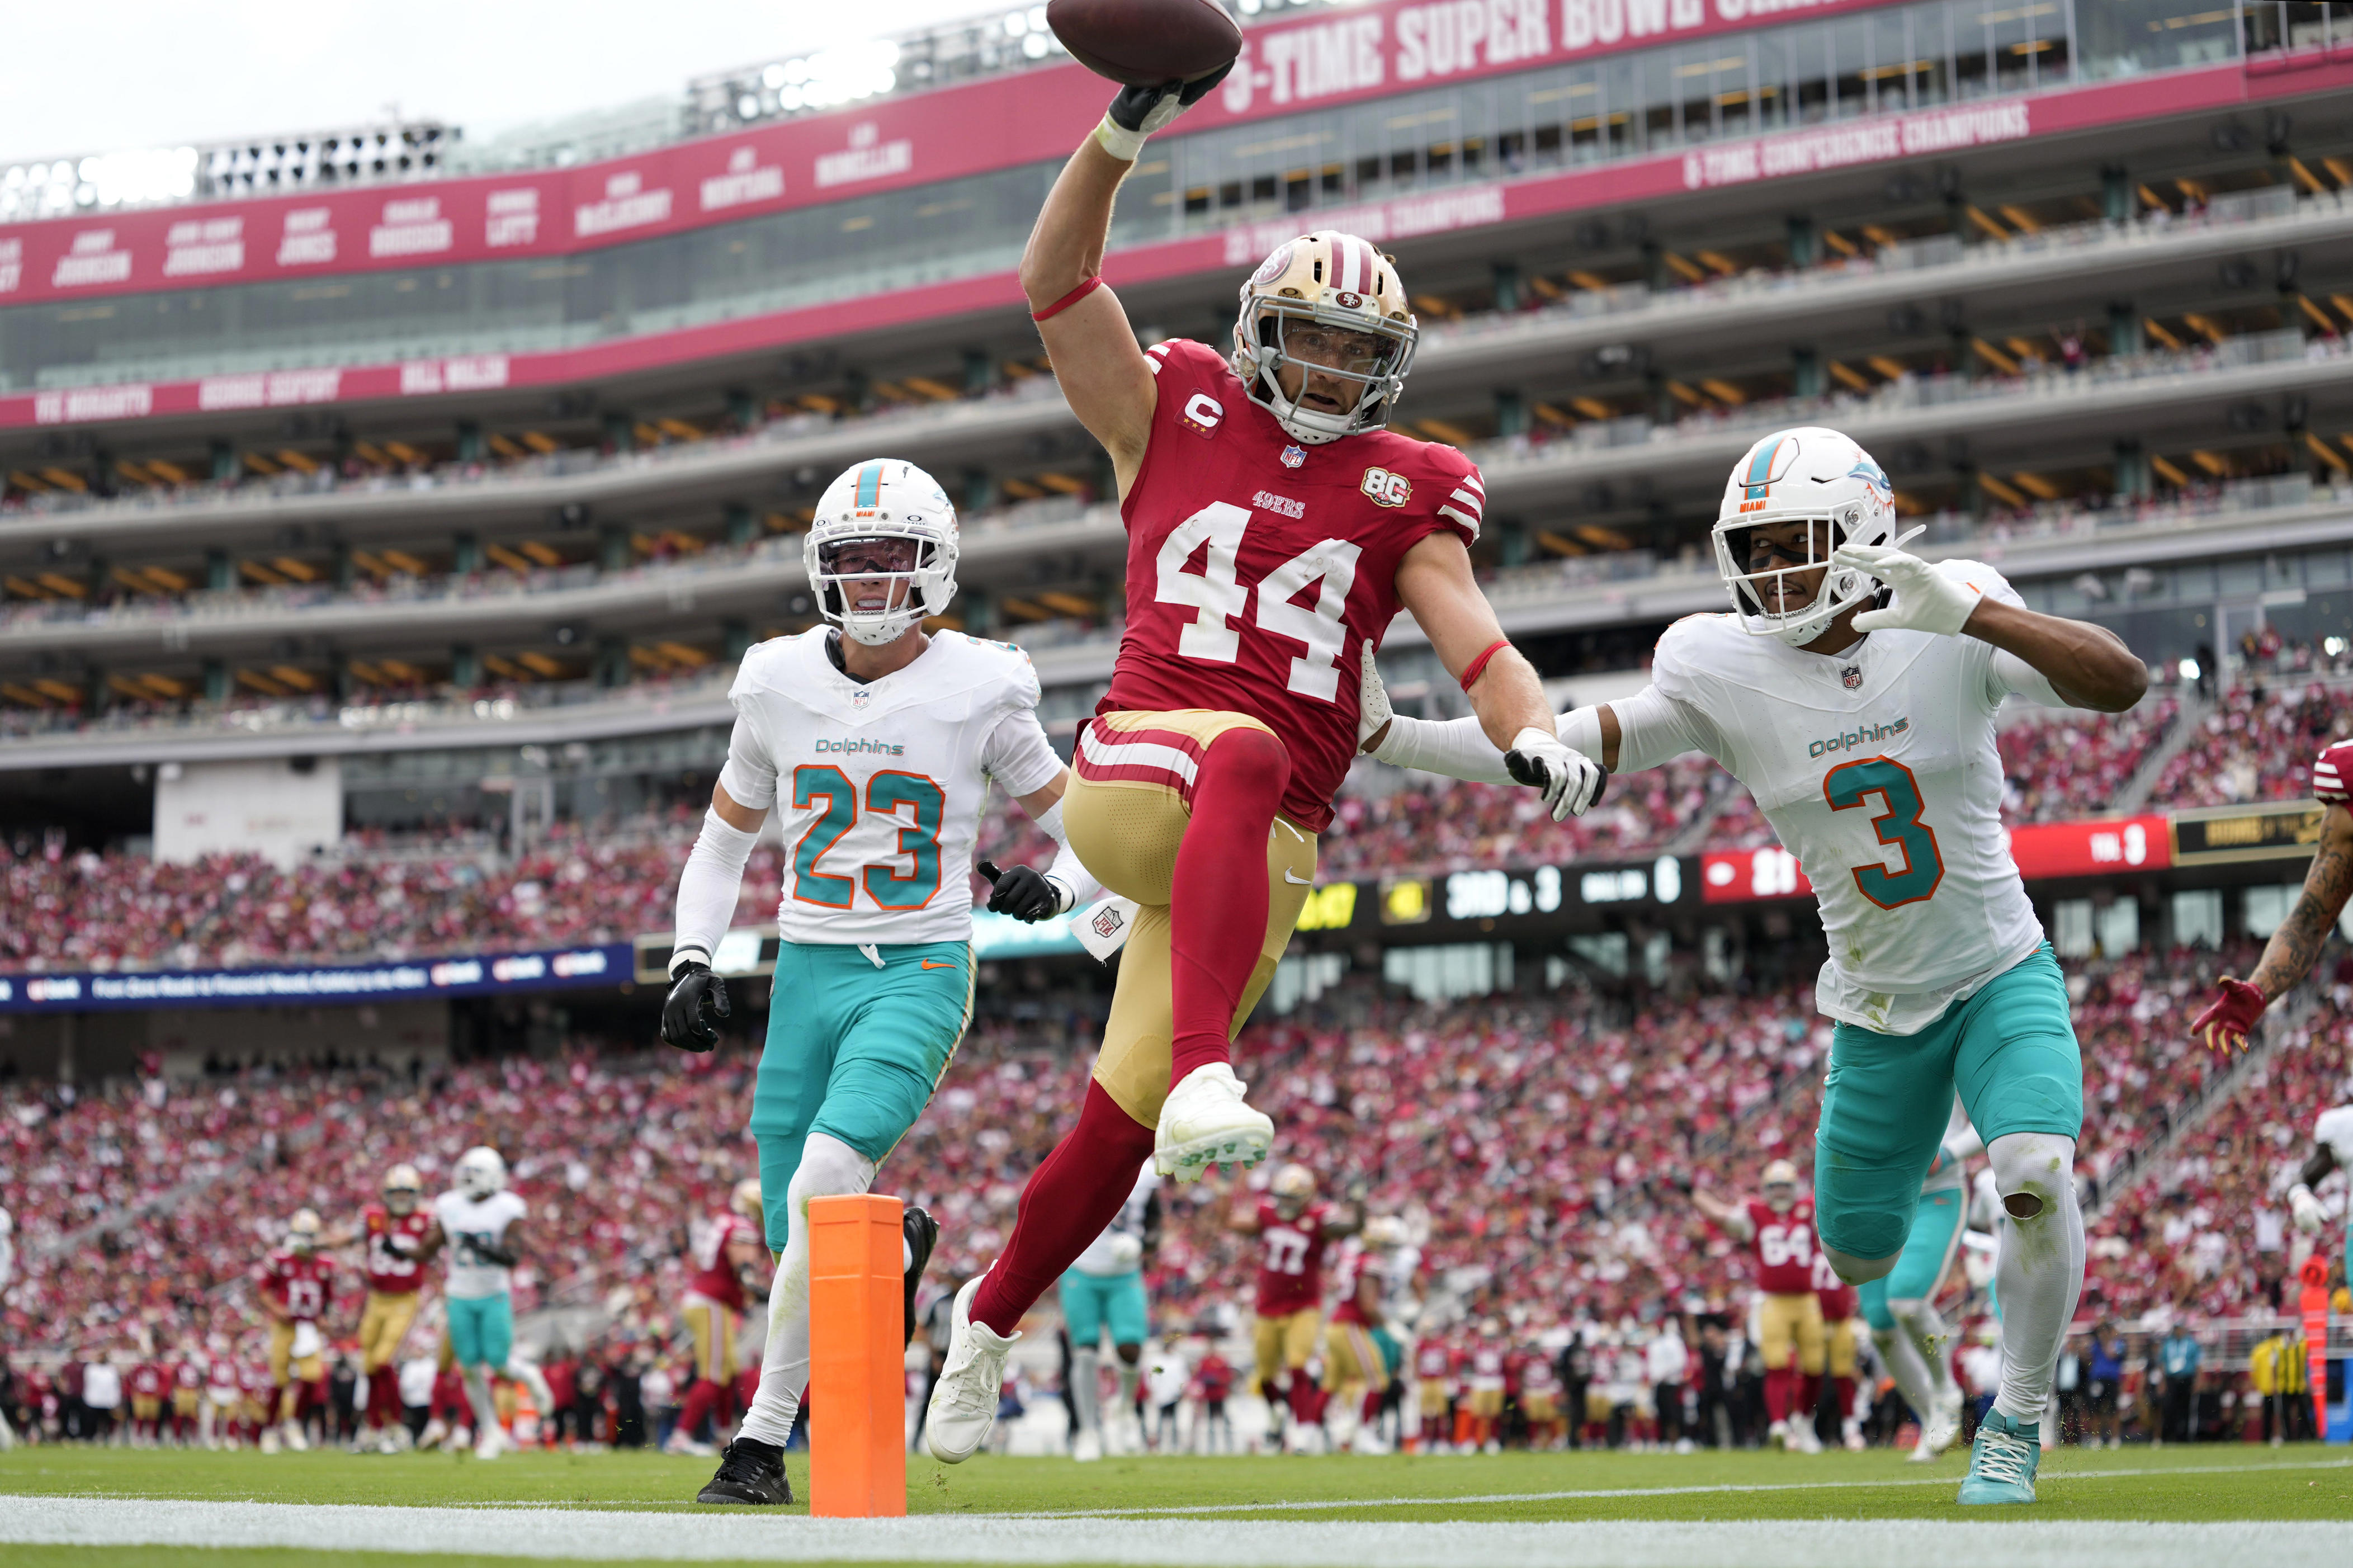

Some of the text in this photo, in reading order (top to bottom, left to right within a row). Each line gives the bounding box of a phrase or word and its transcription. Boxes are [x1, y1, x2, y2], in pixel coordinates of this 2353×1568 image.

[1396, 0, 1551, 81] SUPER
[1183, 393, 1223, 427] C
[1284, 453, 1299, 464] NFL
[1252, 490, 1306, 519] 49ERS
[1740, 500, 1766, 513] MIAMI
[1154, 500, 1363, 703] 44
[1845, 675, 1860, 688] NFL
[815, 738, 905, 756] Dolphins
[1809, 716, 1909, 758] Dolphins
[792, 764, 946, 910] 23
[1823, 754, 1945, 911] 3
[1263, 1227, 1310, 1275] 77
[1759, 1224, 1812, 1267] 64
